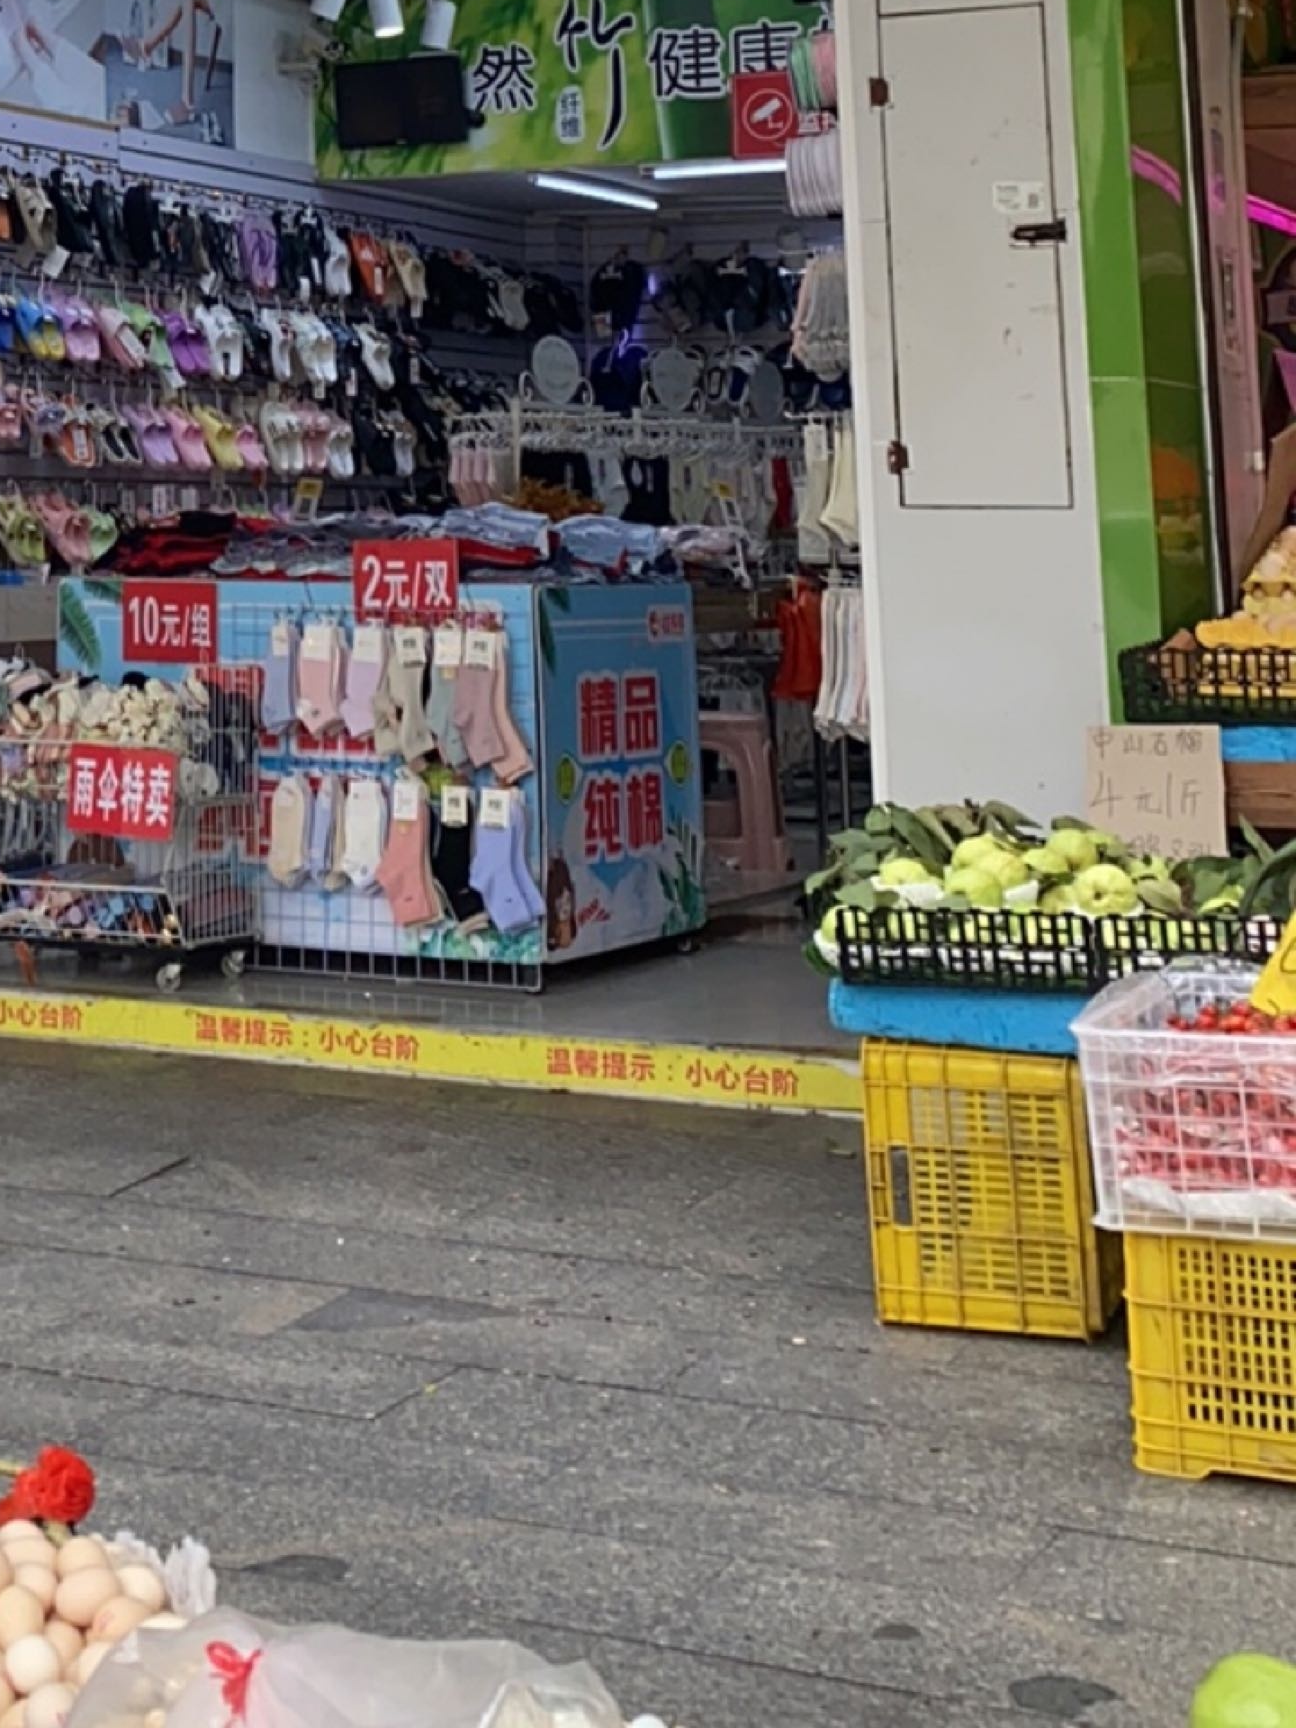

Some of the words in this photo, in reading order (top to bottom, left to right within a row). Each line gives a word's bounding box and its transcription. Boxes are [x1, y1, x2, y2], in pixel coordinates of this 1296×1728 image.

[361, 554, 453, 609] 2元/双
[128, 595, 212, 648] 10元/组
[72, 757, 172, 828] 雨伞特卖
[584, 771, 663, 858] 纯棉
